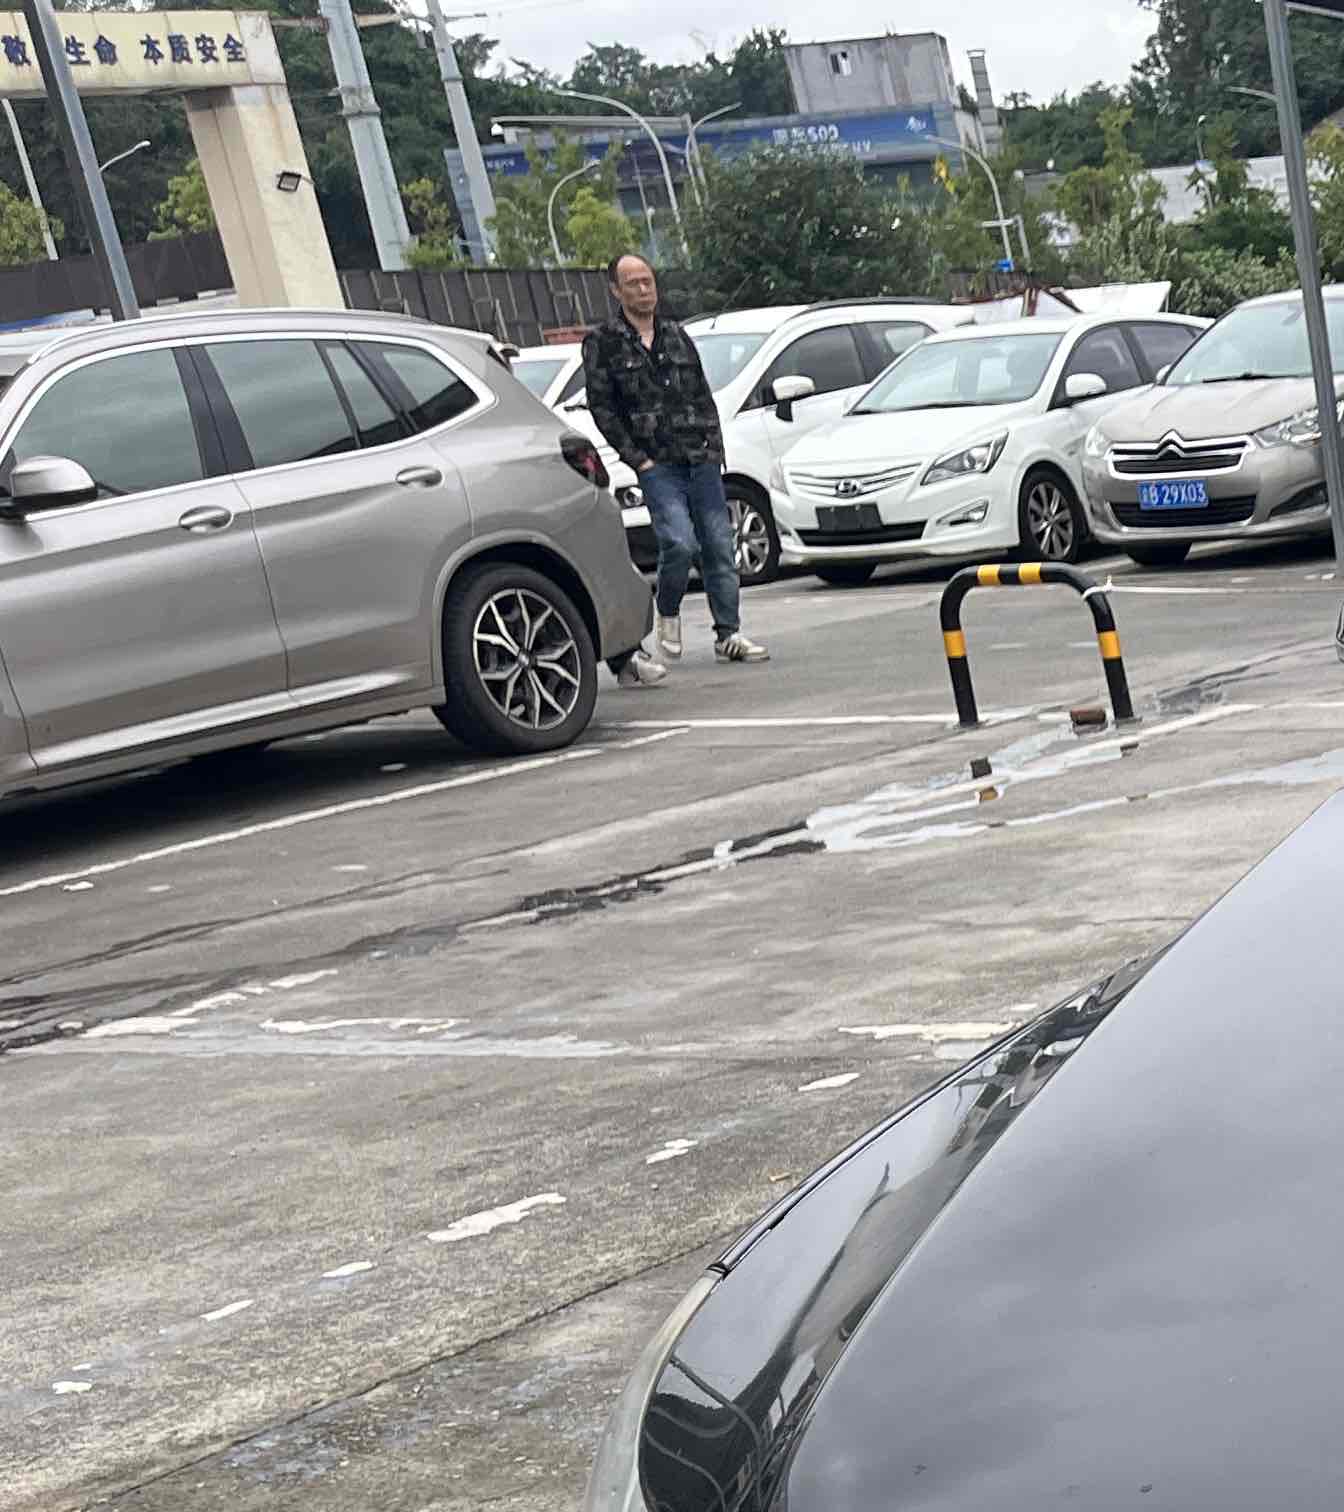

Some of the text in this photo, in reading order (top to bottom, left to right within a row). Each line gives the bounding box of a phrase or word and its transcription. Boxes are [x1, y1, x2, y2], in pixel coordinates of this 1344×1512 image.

[1, 33, 246, 66] 敬生命 本质安全
